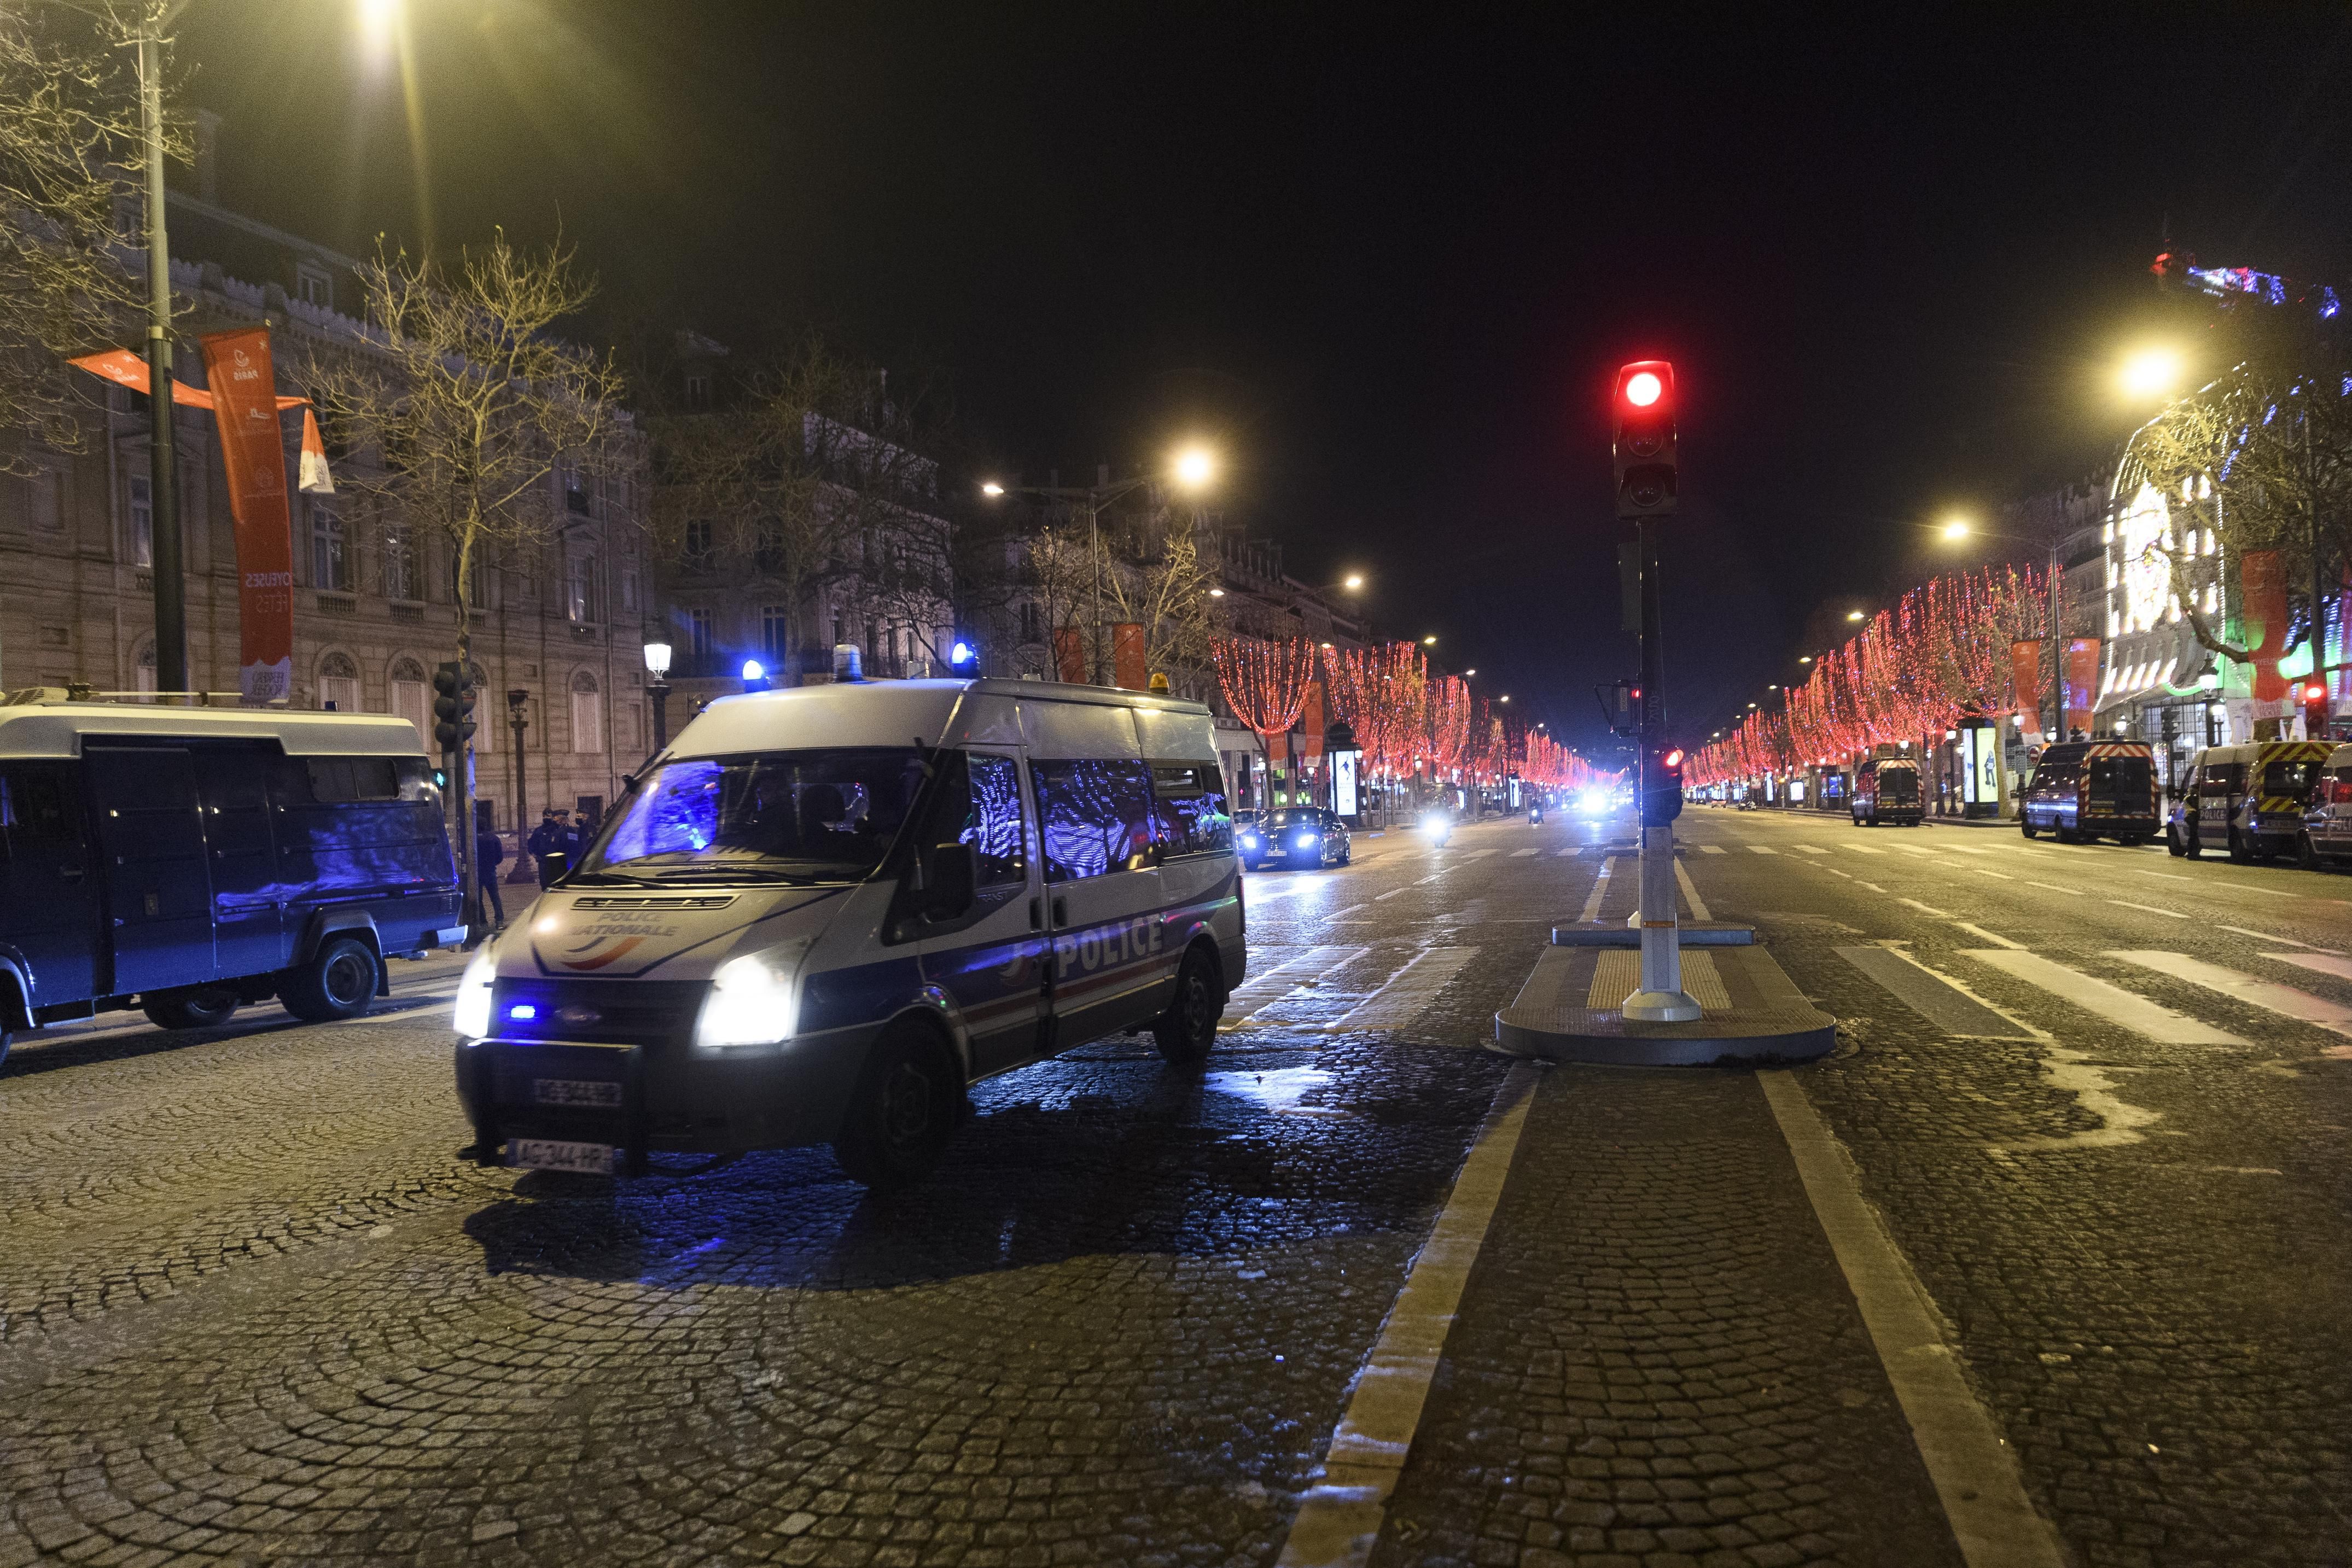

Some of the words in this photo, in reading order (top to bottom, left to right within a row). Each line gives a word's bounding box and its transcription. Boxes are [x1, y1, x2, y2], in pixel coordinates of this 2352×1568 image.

[2199, 809, 2225, 820] POLICE
[597, 912, 666, 922] POLICE
[569, 924, 679, 936] NATIONALE
[1057, 913, 1163, 978] POLICE
